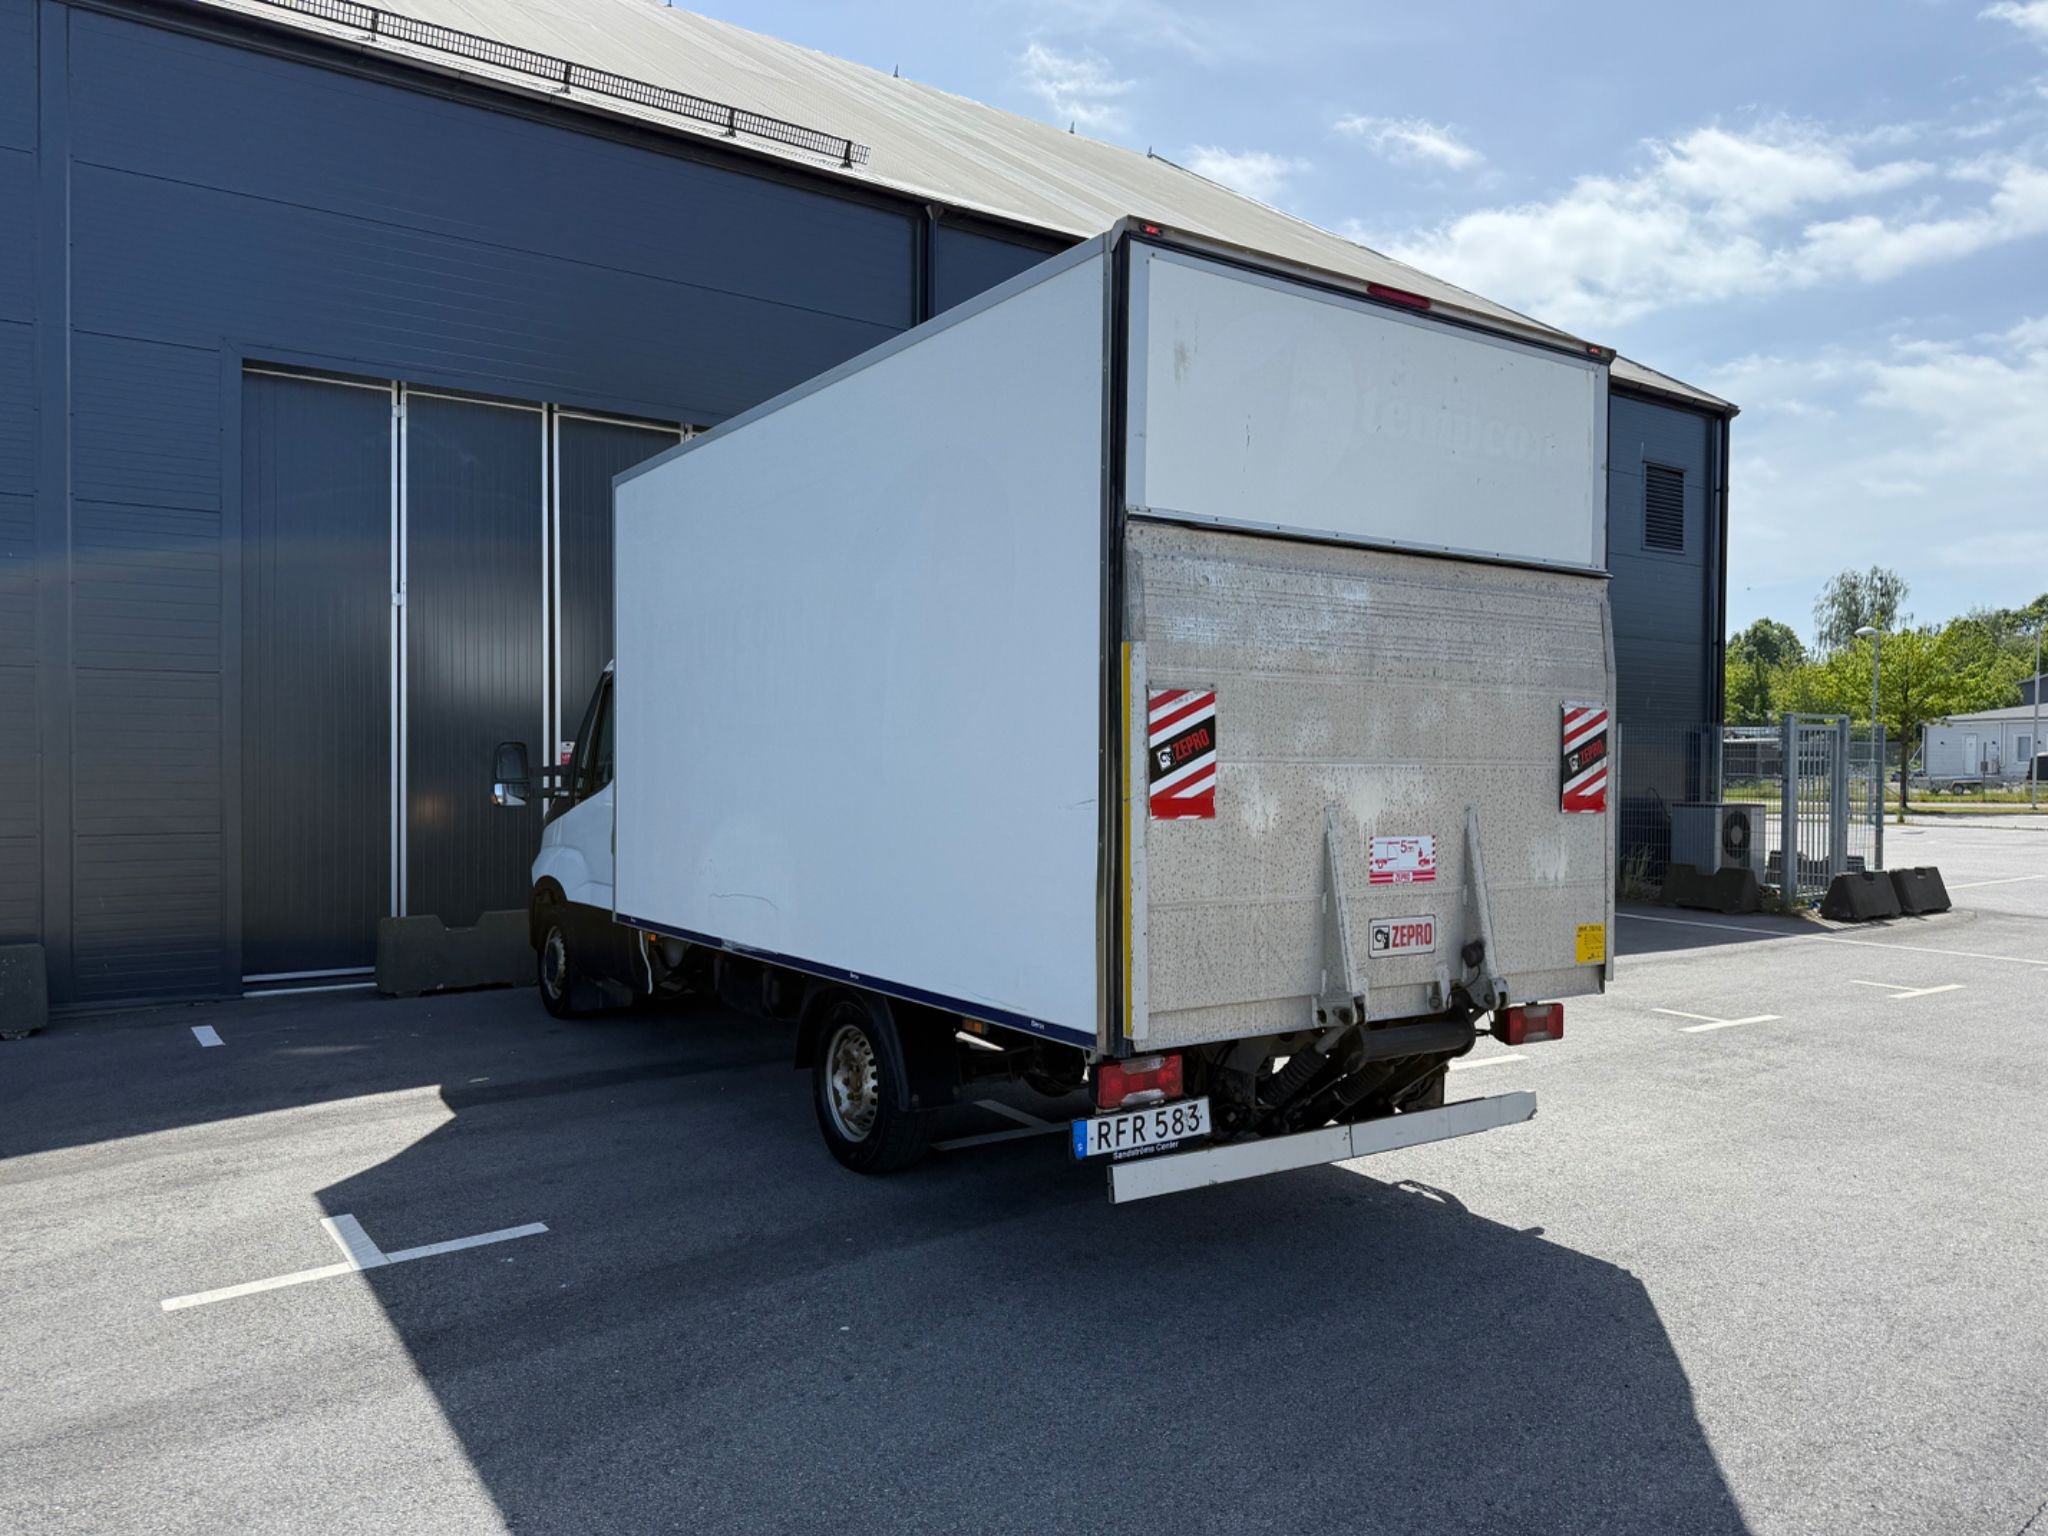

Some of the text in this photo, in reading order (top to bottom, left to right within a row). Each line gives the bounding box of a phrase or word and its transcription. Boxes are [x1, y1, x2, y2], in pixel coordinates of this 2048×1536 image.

[1172, 727, 1209, 761] ZEPRO
[1579, 739, 1604, 766] ZEPRO
[1400, 839, 1407, 853] 5
[1391, 922, 1432, 948] ZEPRO
[1098, 1104, 1200, 1150] RFR 583
[1156, 1141, 1180, 1153] Center
